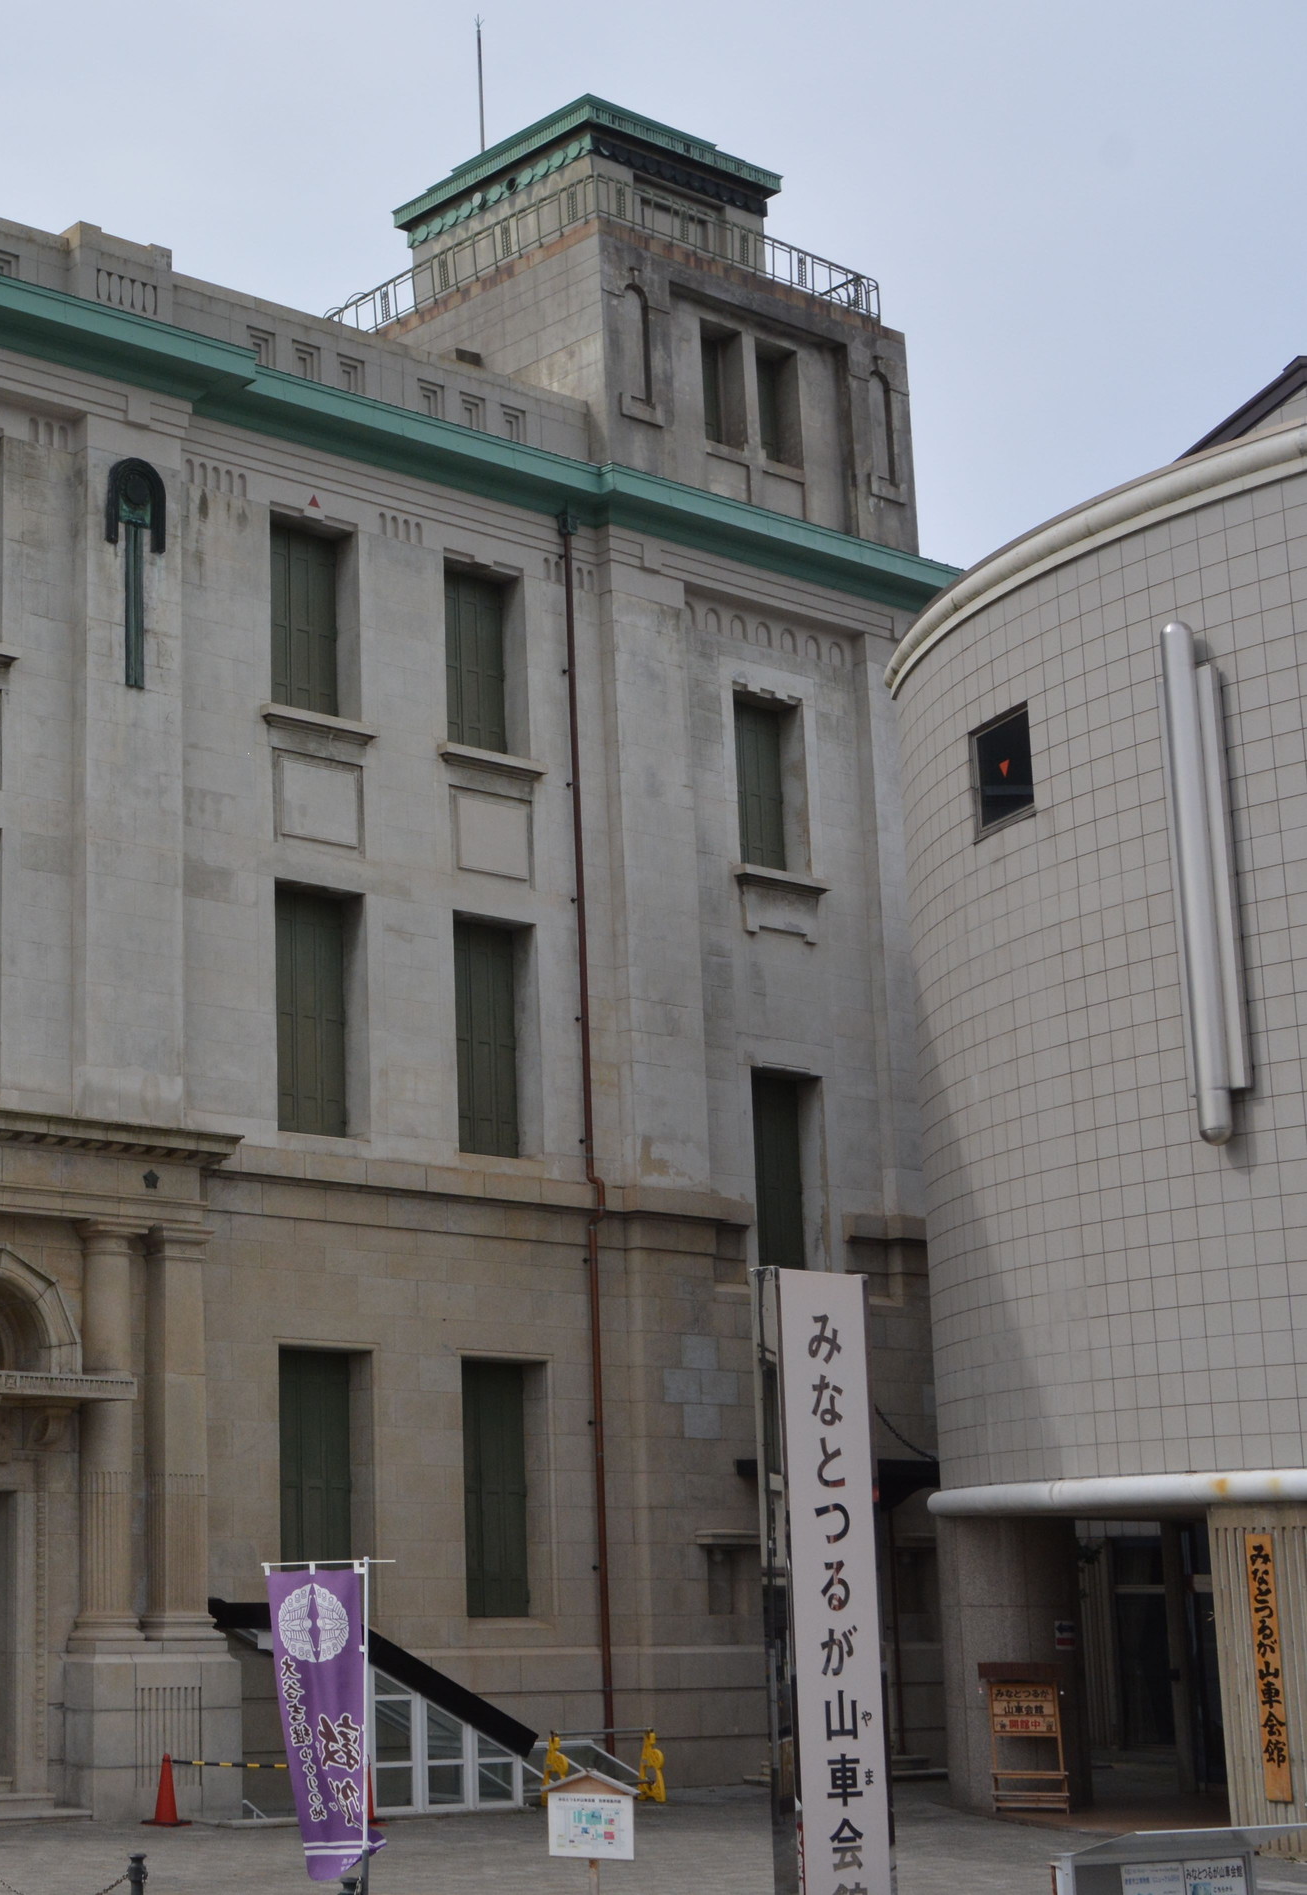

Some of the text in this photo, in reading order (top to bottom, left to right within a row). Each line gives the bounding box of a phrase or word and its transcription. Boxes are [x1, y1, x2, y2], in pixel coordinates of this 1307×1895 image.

[807, 1313, 868, 1895] みなとつるが山車会
[1249, 1544, 1287, 1769] みなとつるが山車会館
[995, 1689, 1049, 1698] みなとつるが
[1003, 1703, 1044, 1715] 山車会館
[1009, 1720, 1041, 1730] 開館中
[1185, 1865, 1244, 1881] みなとつるが山車会館
